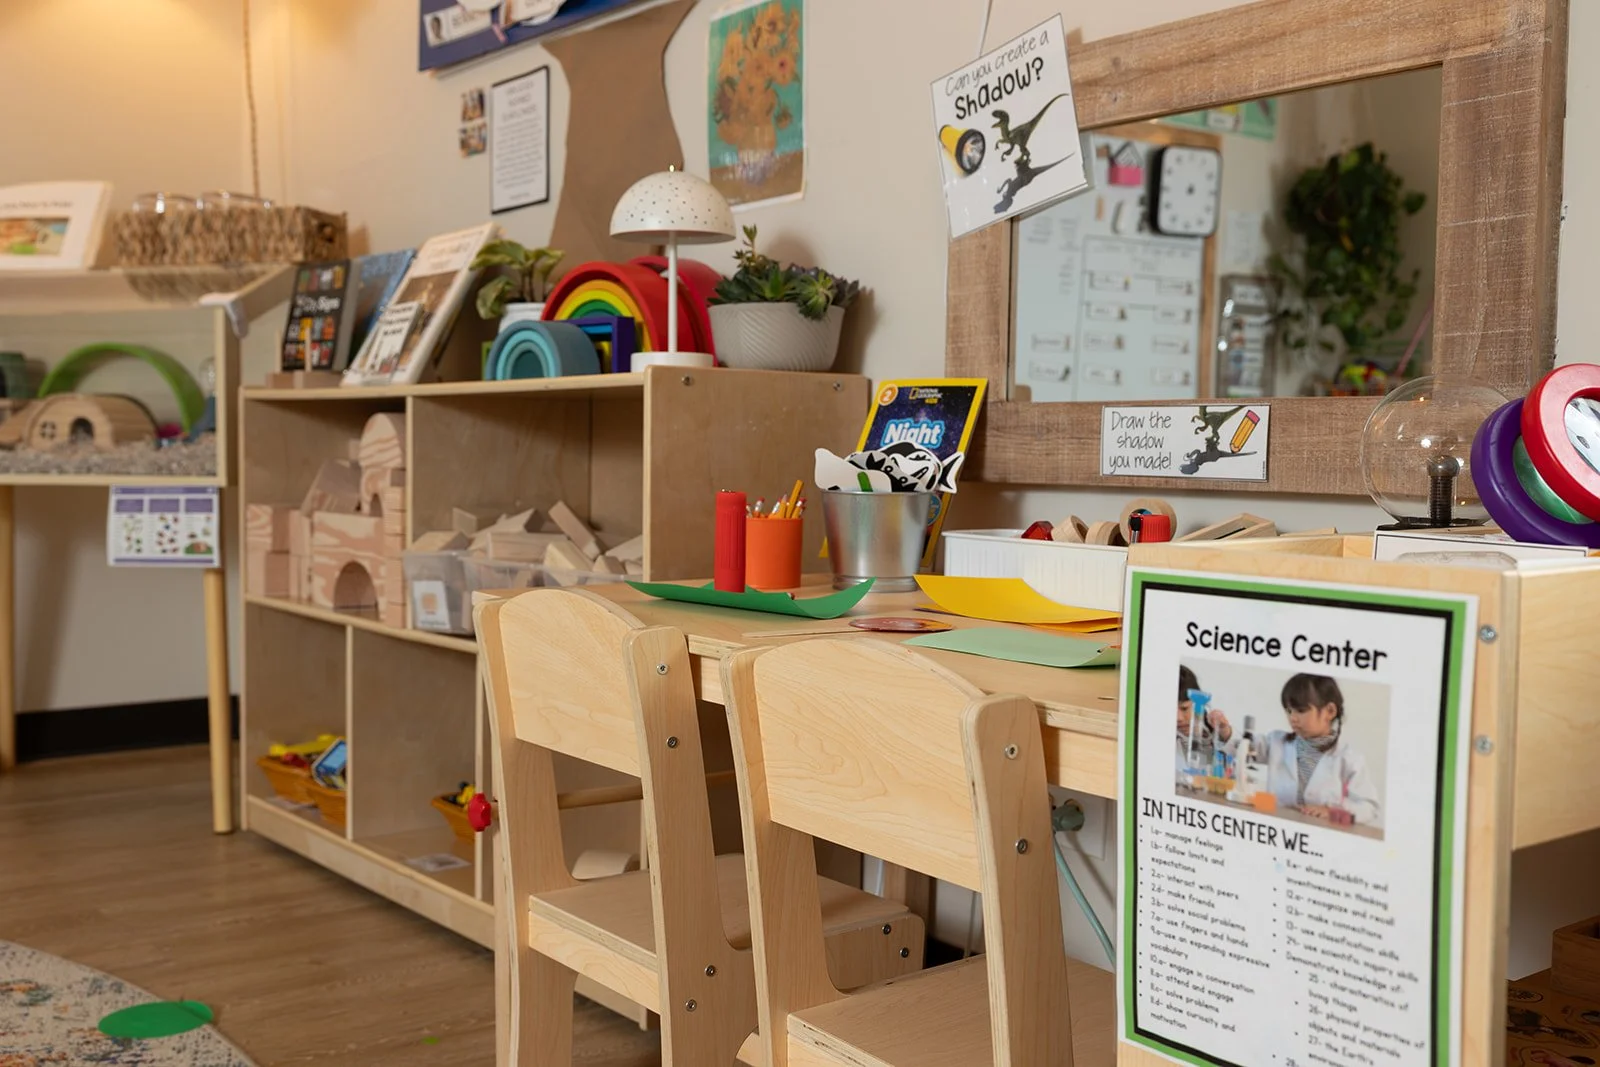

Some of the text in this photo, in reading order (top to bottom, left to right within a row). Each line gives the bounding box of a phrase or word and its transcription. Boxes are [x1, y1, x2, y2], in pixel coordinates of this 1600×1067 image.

[945, 29, 1050, 97] Can you create a
[883, 390, 892, 402] 2
[1111, 411, 1171, 431] Draw the
[1117, 432, 1164, 449] shadow
[1109, 452, 1172, 475] you made!
[1185, 621, 1388, 672] Science Center
[1142, 797, 1164, 820] IN
[1166, 802, 1208, 830] THIS
[1211, 814, 1278, 848] CENTER
[1165, 831, 1192, 843] manage
[1195, 837, 1224, 852] feelings
[1151, 857, 1196, 873] expectations
[1165, 844, 1186, 856] follow
[1188, 850, 1208, 863] limits
[1211, 857, 1225, 867] and
[1167, 875, 1196, 888] interact
[1199, 884, 1215, 894] with
[1217, 889, 1239, 900] peers
[1372, 882, 1389, 893] and
[1168, 890, 1186, 900] make
[1188, 894, 1215, 909] friends
[1307, 896, 1349, 914] recognize
[1352, 909, 1367, 919] and
[1354, 893, 1389, 912] thinking
[1167, 904, 1185, 914] solve
[1188, 911, 1209, 921] social
[1211, 916, 1246, 932] problems
[1166, 919, 1178, 927] use
[1181, 920, 1208, 936] fingers
[1211, 932, 1224, 941] and
[1226, 934, 1249, 948] hands
[1331, 919, 1383, 940] connections
[1150, 942, 1189, 960] vocabulary
[1317, 931, 1375, 953] classification
[1189, 939, 1227, 957] expanding
[1229, 951, 1270, 969] expressive
[1169, 962, 1195, 976] engage
[1205, 974, 1256, 995] conversation
[1286, 950, 1340, 975] Demonstrate
[1342, 968, 1387, 990] knowledge
[1166, 974, 1190, 988] attend
[1192, 983, 1205, 994] and
[1208, 989, 1235, 1003] engage
[1166, 988, 1183, 1000] solve
[1185, 996, 1220, 1013] problems
[1332, 997, 1358, 1013] things
[1150, 1012, 1188, 1030] motivation
[1166, 1002, 1184, 1014] show
[1186, 1009, 1219, 1028] curiosity
[1221, 1022, 1237, 1032] and
[1341, 1033, 1357, 1044] and
[1362, 1025, 1411, 1046] properties
